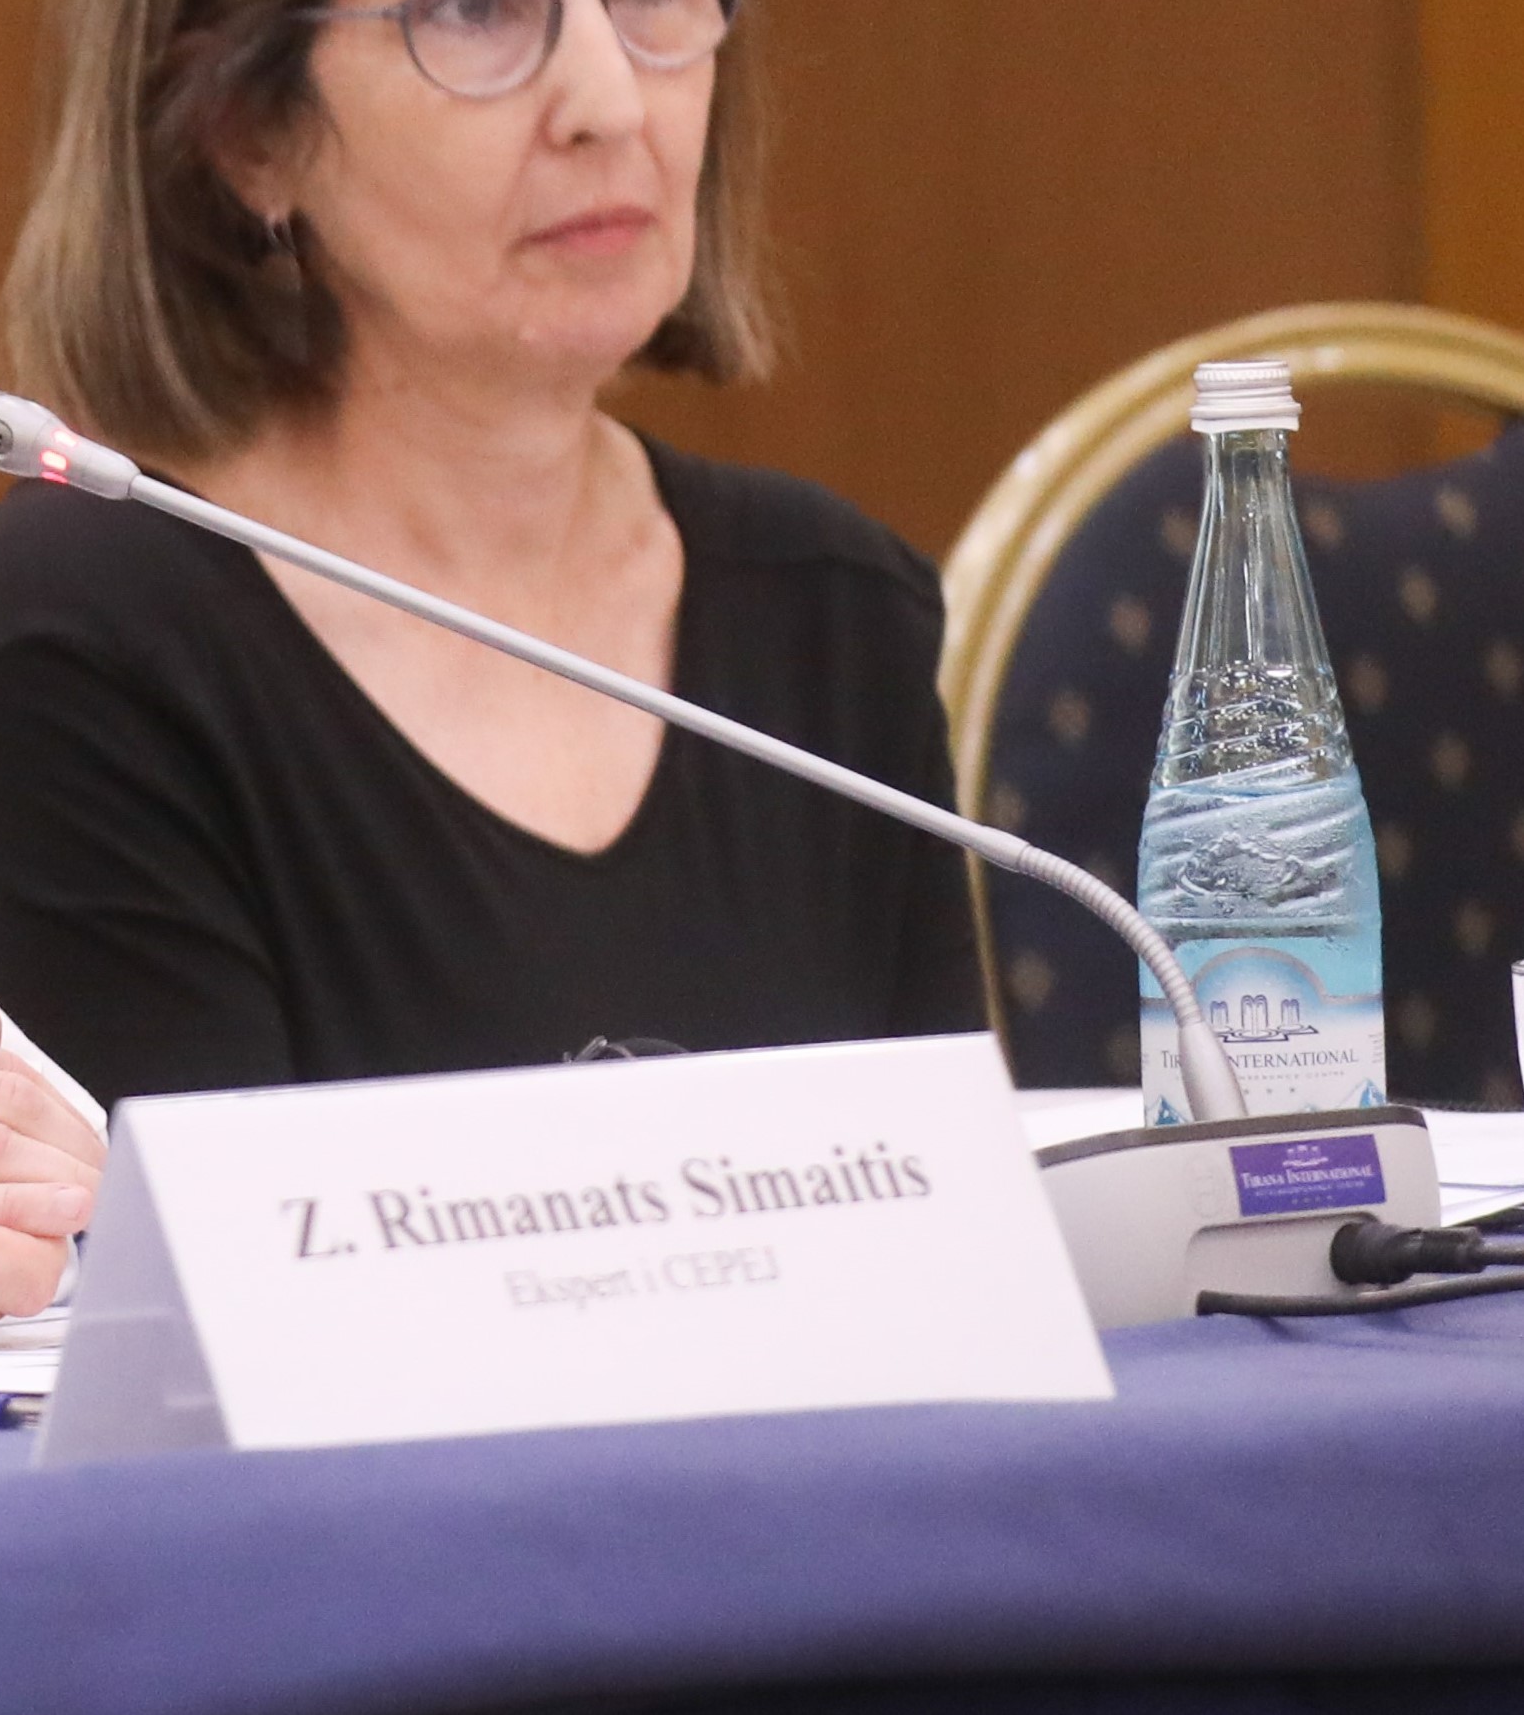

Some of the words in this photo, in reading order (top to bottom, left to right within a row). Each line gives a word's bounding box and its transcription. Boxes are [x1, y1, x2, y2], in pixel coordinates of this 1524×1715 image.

[1226, 1049, 1358, 1069] NTERNATIONAL
[280, 1196, 358, 1258] Z.
[368, 1172, 670, 1251] Rimanats
[680, 1140, 932, 1220] Simaitis
[502, 1266, 638, 1314] Ekspert
